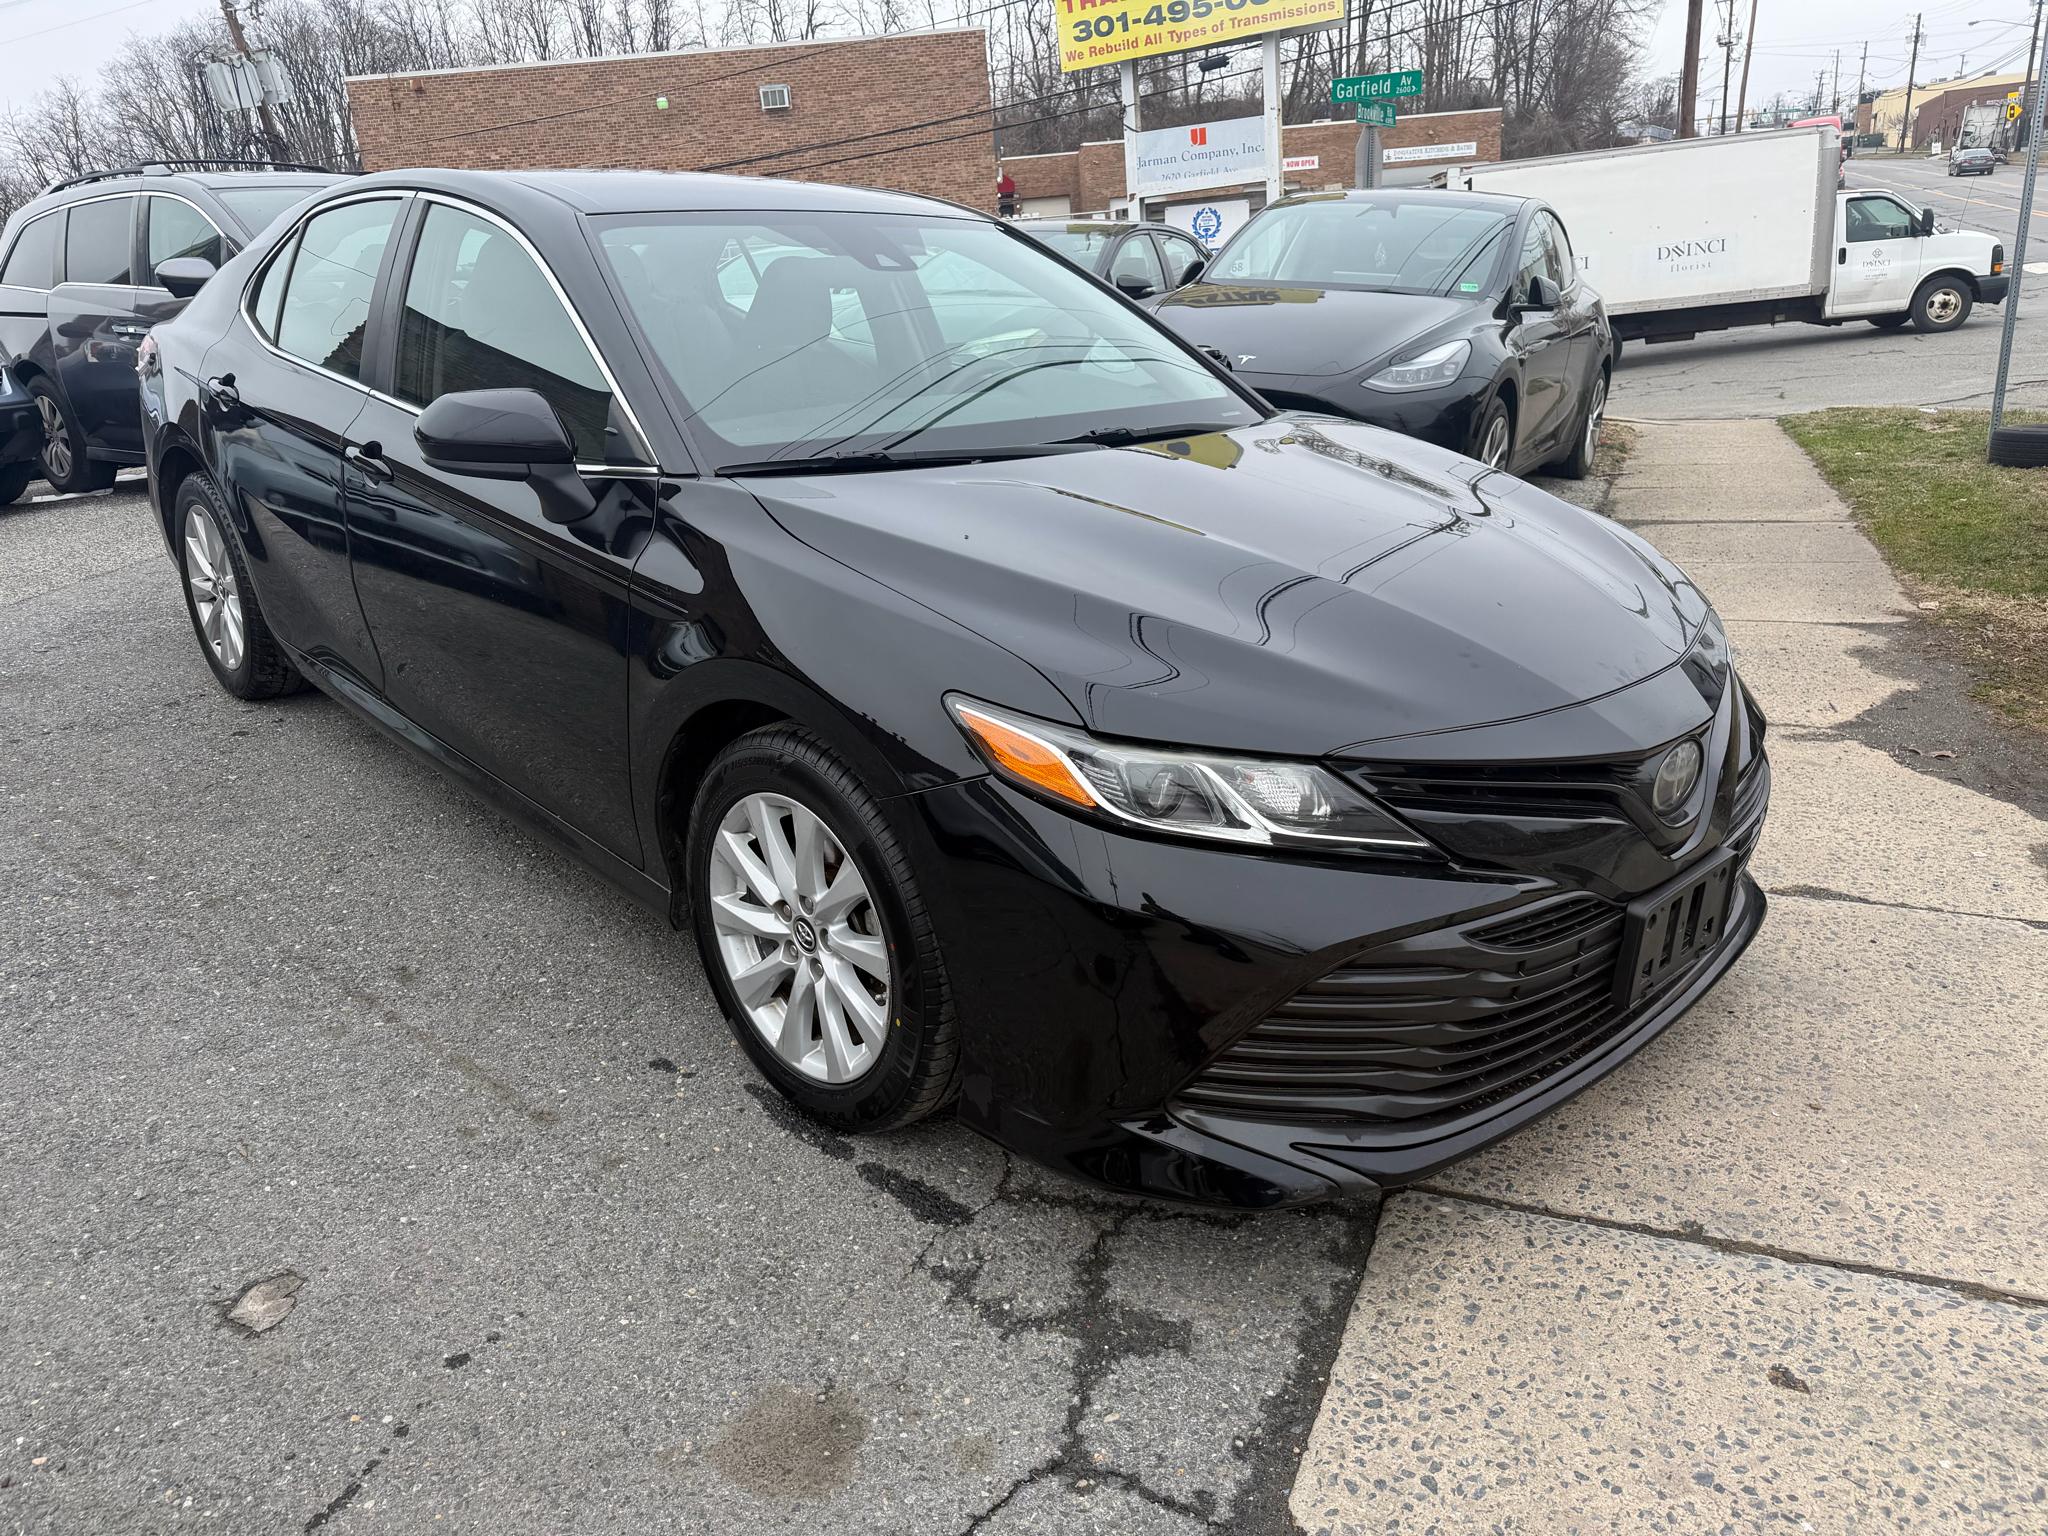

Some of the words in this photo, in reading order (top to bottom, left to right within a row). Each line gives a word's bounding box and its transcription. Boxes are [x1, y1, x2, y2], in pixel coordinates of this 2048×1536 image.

[1066, 50, 1084, 62] We
[1089, 37, 1139, 57] Rebuild
[1144, 32, 1162, 47] All
[1167, 27, 1207, 43] Types
[1211, 19, 1224, 33] of
[1229, 1, 1335, 29] Transmissions
[1336, 78, 1391, 99] Garfield
[1400, 75, 1412, 86] Av
[1136, 156, 1177, 170] Jarman
[1241, 142, 1265, 154] Inc.
[1184, 167, 1219, 179] Garfield
[1670, 261, 1711, 272] florist
